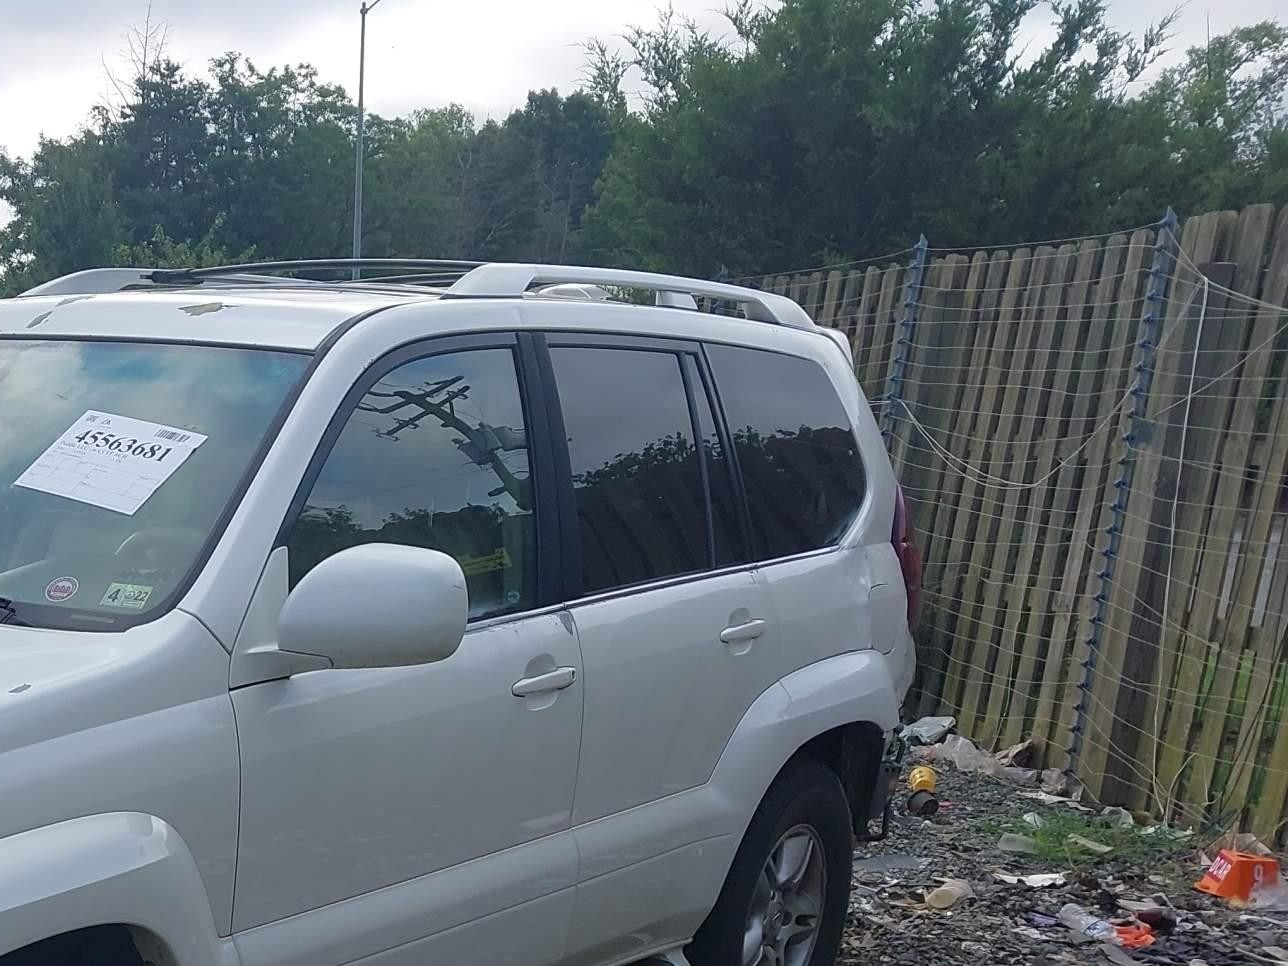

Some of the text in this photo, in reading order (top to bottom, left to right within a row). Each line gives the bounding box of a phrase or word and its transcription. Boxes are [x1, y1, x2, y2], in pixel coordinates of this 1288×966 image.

[75, 429, 173, 462] 45563681
[108, 588, 148, 602] 4 22
